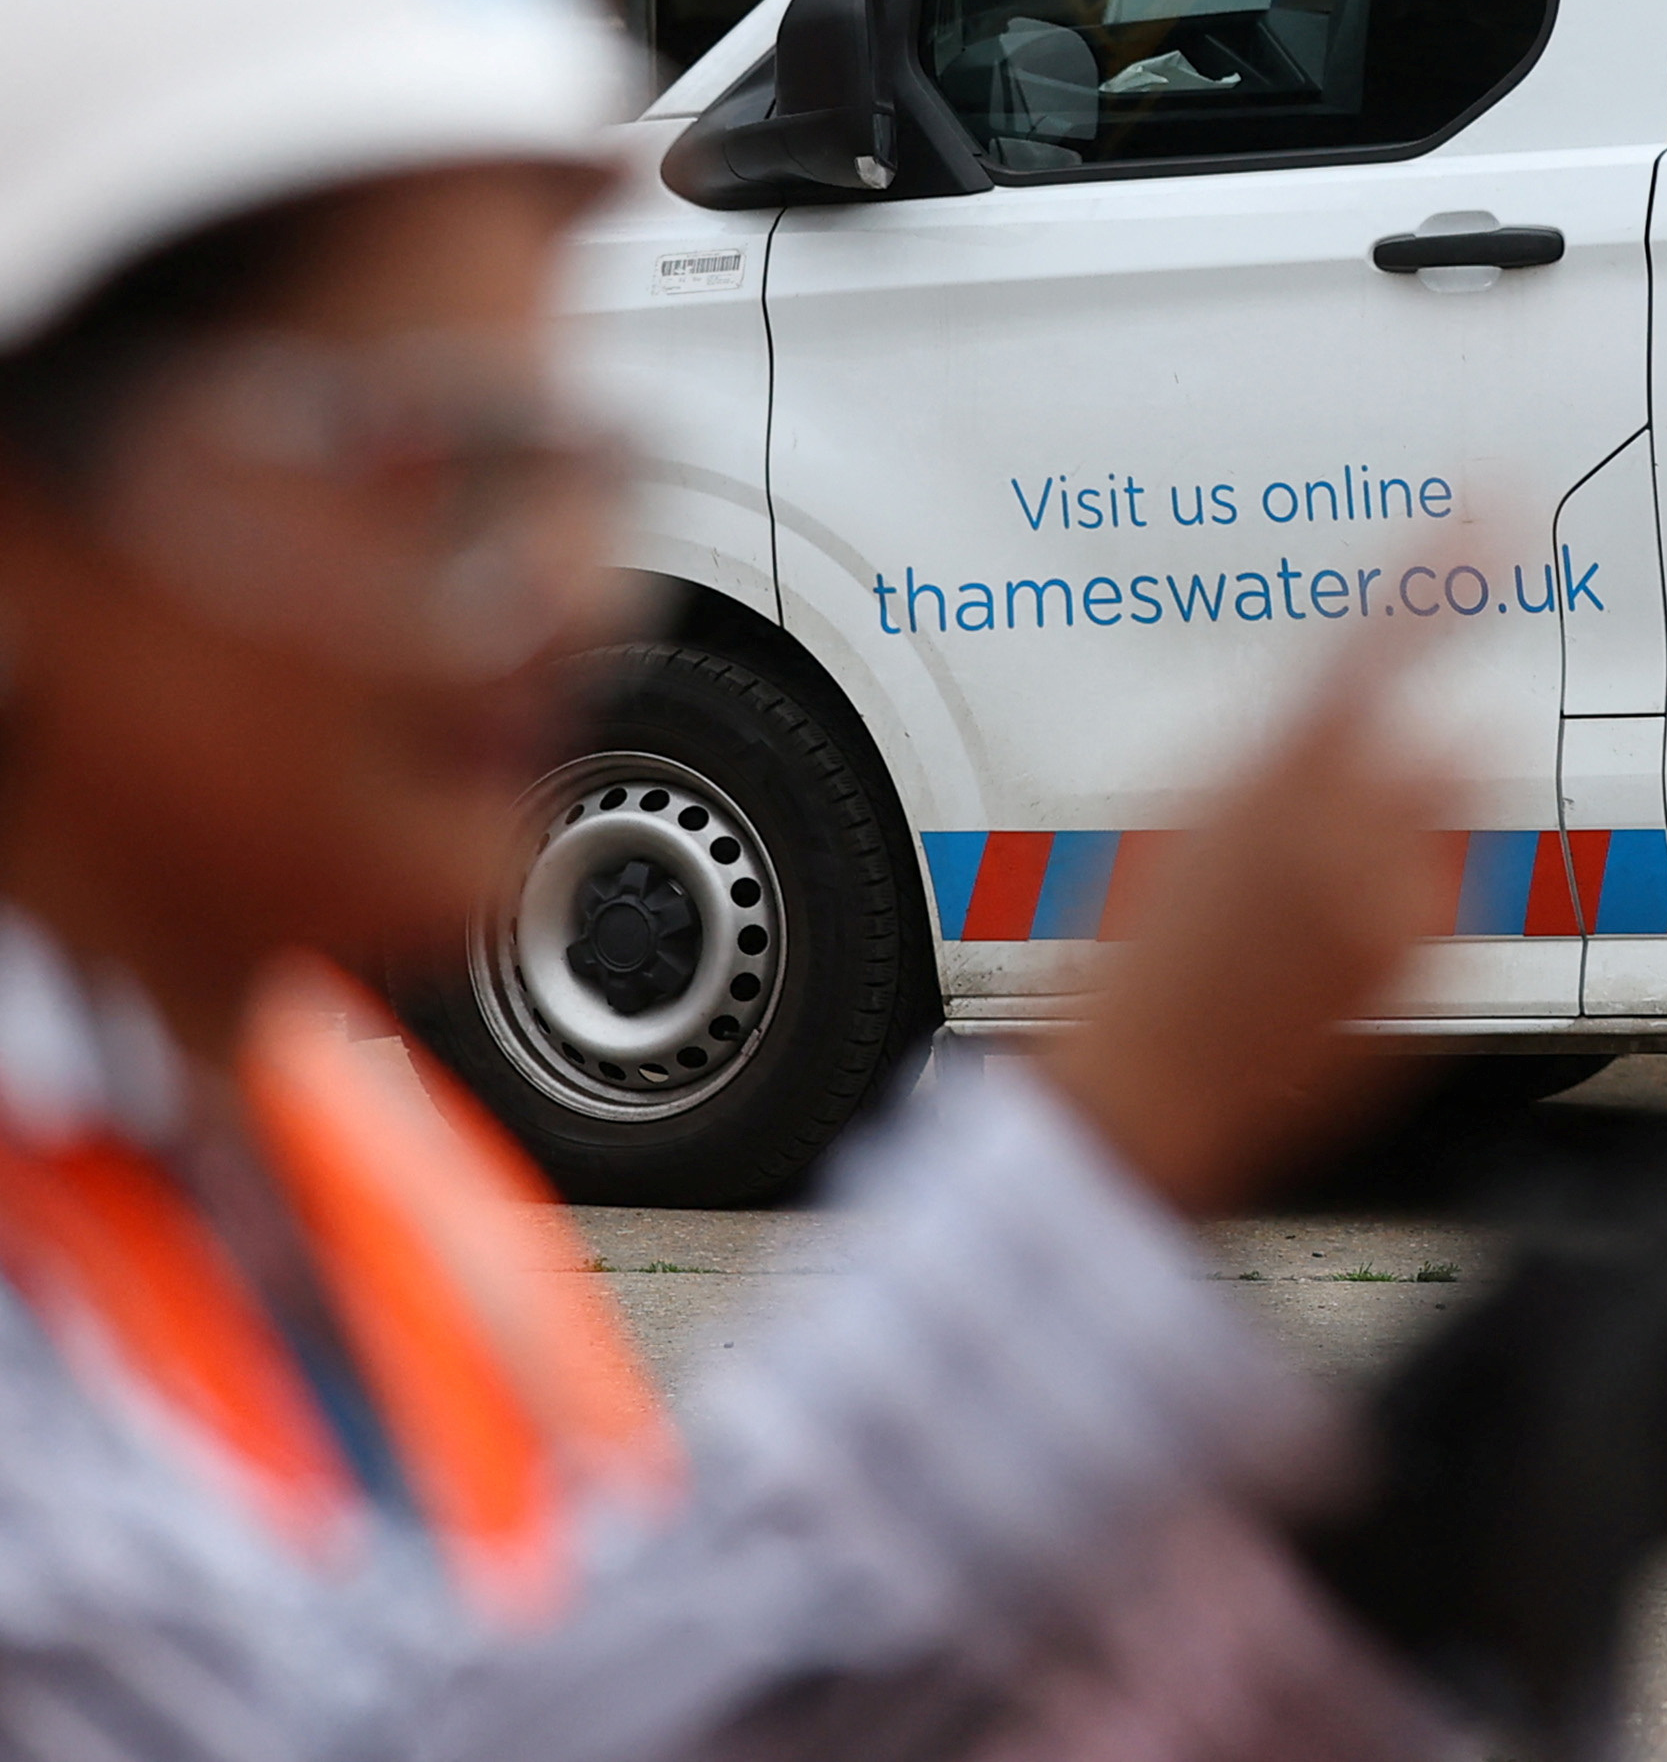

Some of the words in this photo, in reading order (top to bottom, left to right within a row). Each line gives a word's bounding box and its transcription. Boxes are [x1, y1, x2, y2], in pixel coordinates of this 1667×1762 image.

[1010, 473, 1148, 531] Visit
[1171, 482, 1236, 527] us
[1261, 464, 1454, 524] online
[873, 543, 1604, 635] thameswater.co.uk
